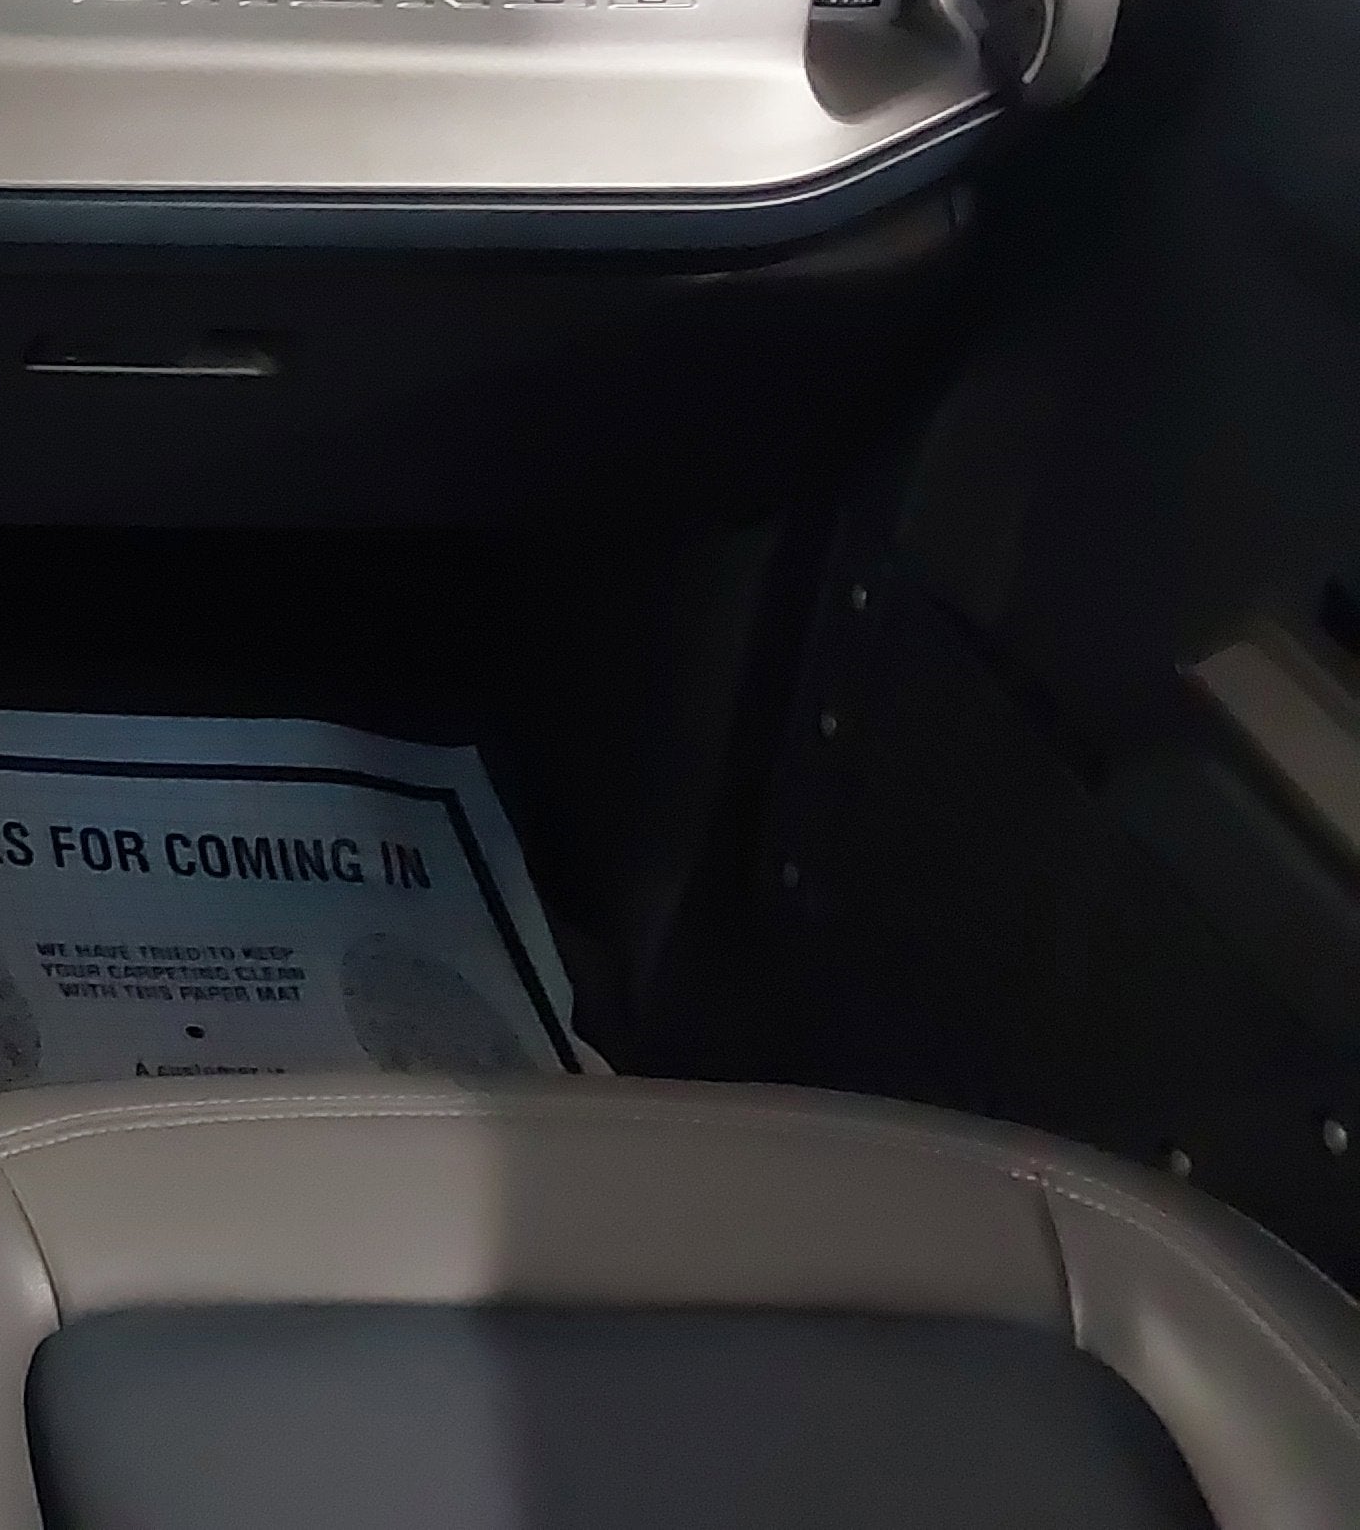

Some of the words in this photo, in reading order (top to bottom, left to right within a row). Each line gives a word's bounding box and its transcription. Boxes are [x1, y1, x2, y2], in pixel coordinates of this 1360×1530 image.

[51, 826, 148, 875] FOR
[166, 831, 364, 888] COMING
[382, 842, 431, 892] IN
[36, 943, 67, 957] WE
[207, 946, 235, 960] TO
[41, 963, 101, 978] YOUR
[107, 964, 230, 981] CARPETING
[235, 966, 307, 981] CLEAN
[58, 983, 117, 999] WITH
[123, 984, 173, 1001] THIS
[179, 985, 251, 1002] PAPER
[256, 986, 301, 1001] MAT
